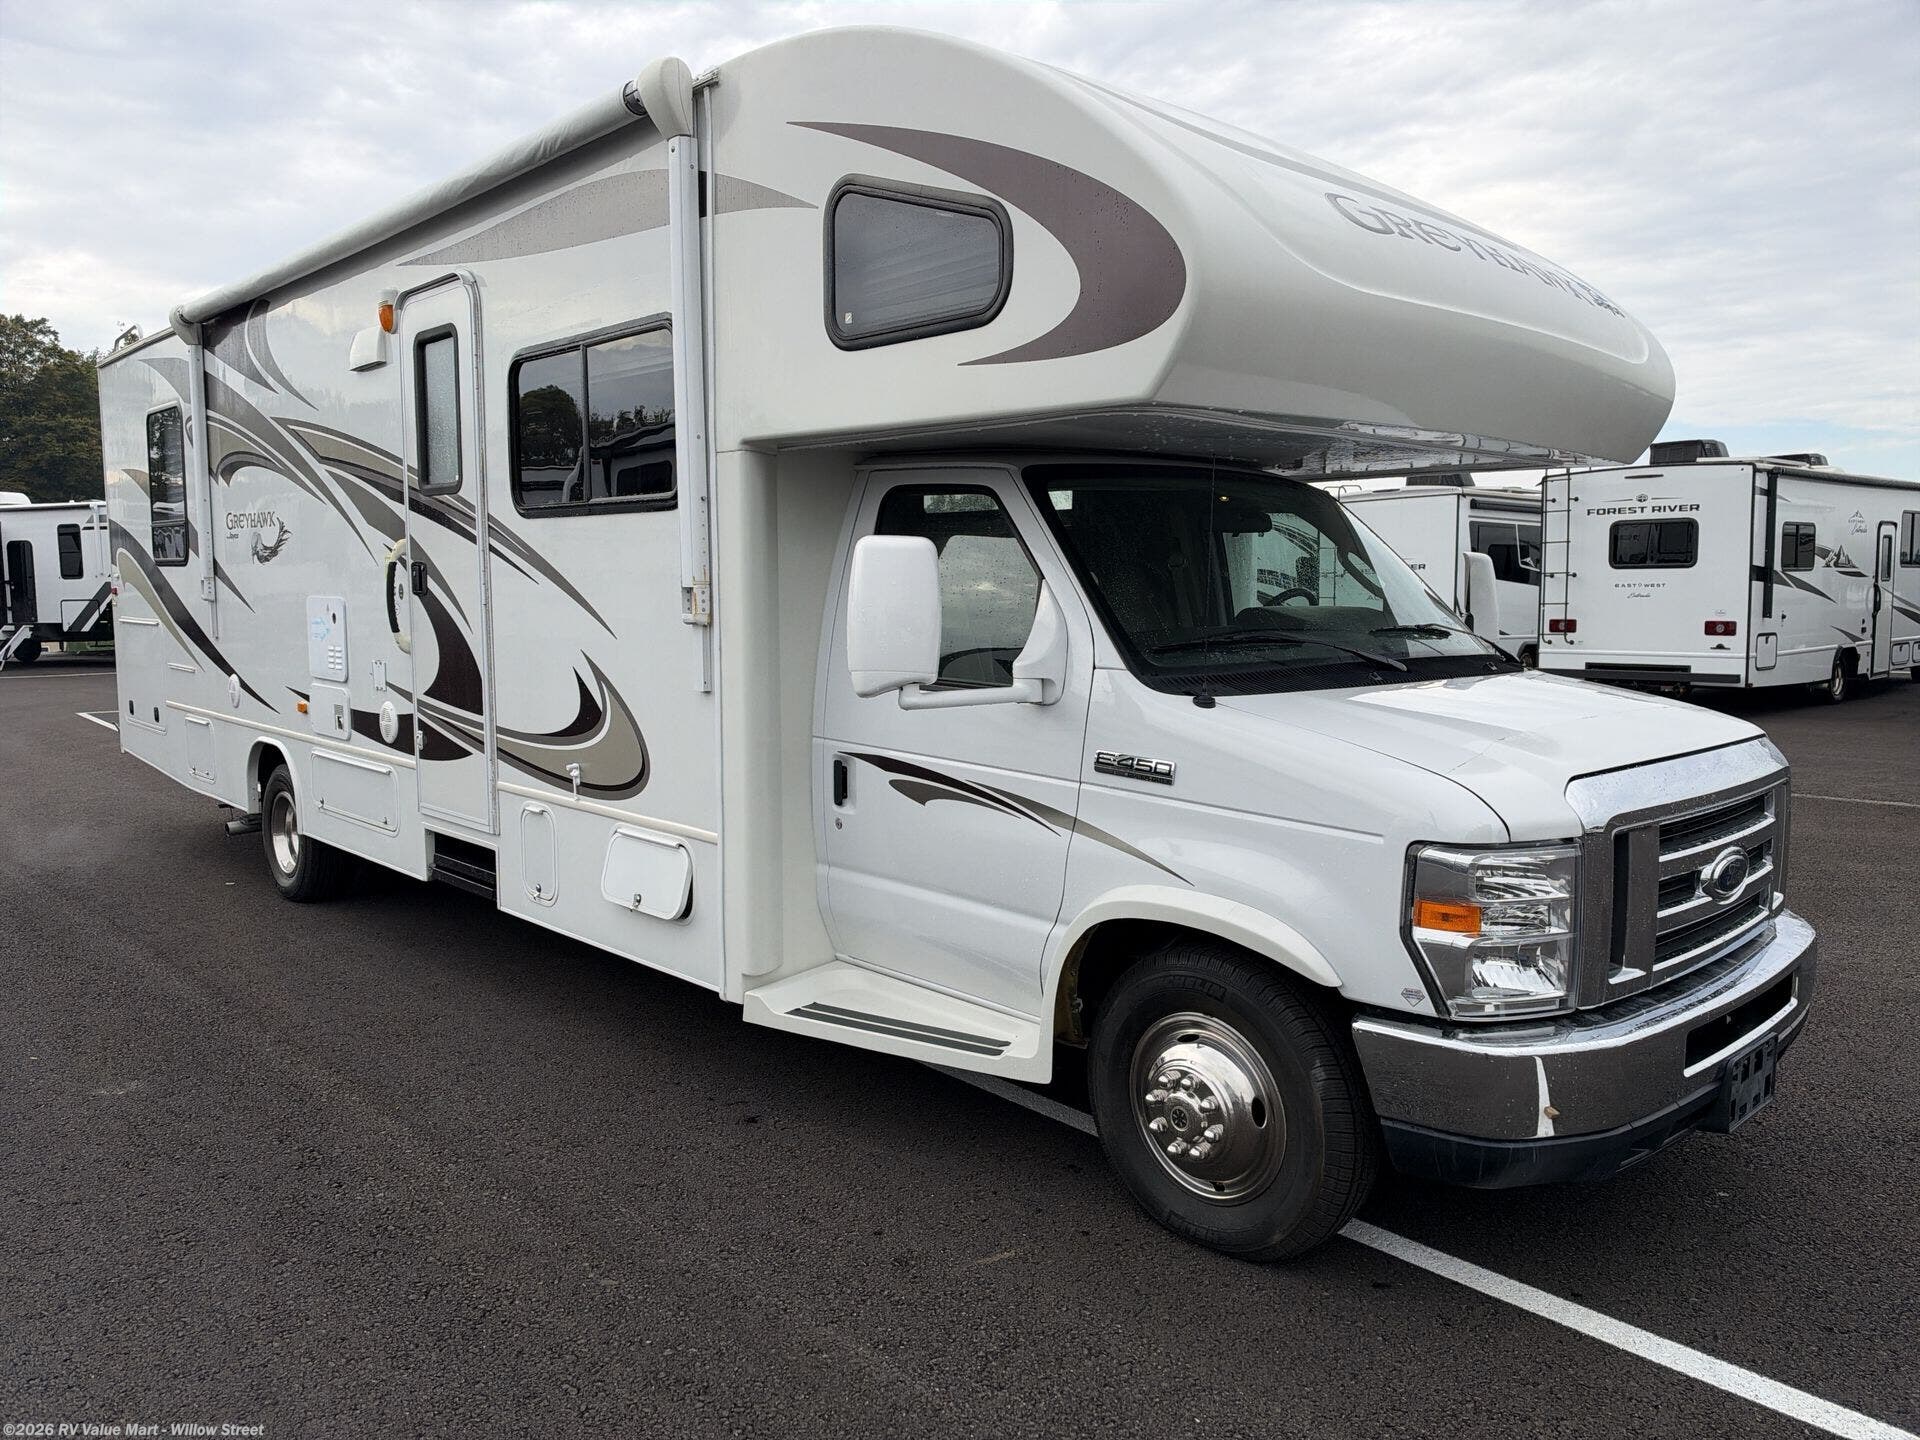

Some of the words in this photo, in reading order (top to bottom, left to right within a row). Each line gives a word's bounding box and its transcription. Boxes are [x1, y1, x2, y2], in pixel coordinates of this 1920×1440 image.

[1586, 506, 1647, 516] FOREST
[1651, 504, 1701, 513] RIVER
[226, 511, 276, 530] GREYHAWK
